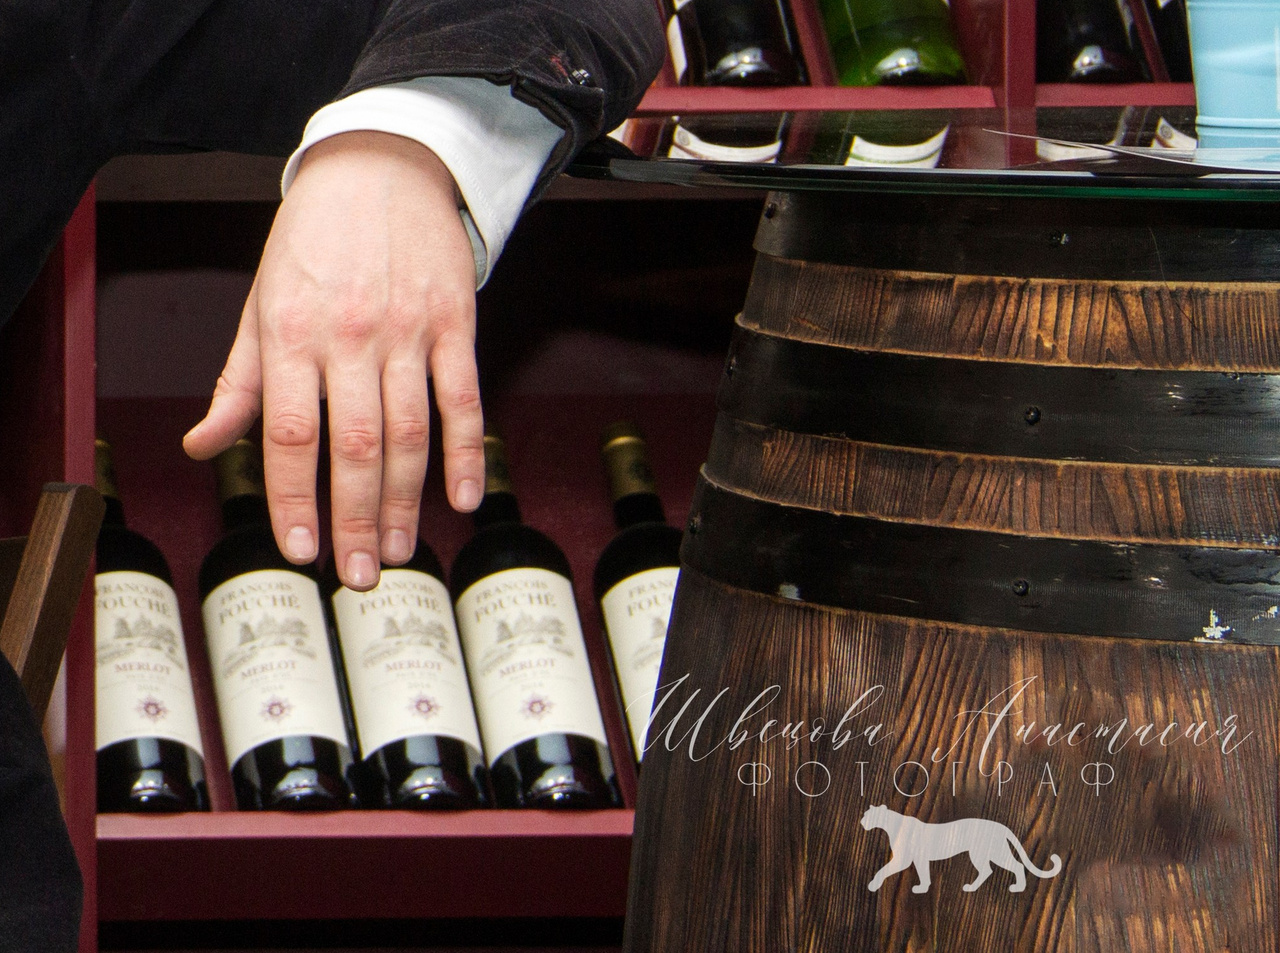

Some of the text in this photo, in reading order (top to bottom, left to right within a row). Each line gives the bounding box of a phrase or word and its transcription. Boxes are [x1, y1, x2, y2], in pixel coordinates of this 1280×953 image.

[114, 661, 171, 675] MERLOT
[241, 659, 297, 679] MERLOT
[385, 658, 442, 673] MERLOT
[499, 656, 556, 677] MERLOT
